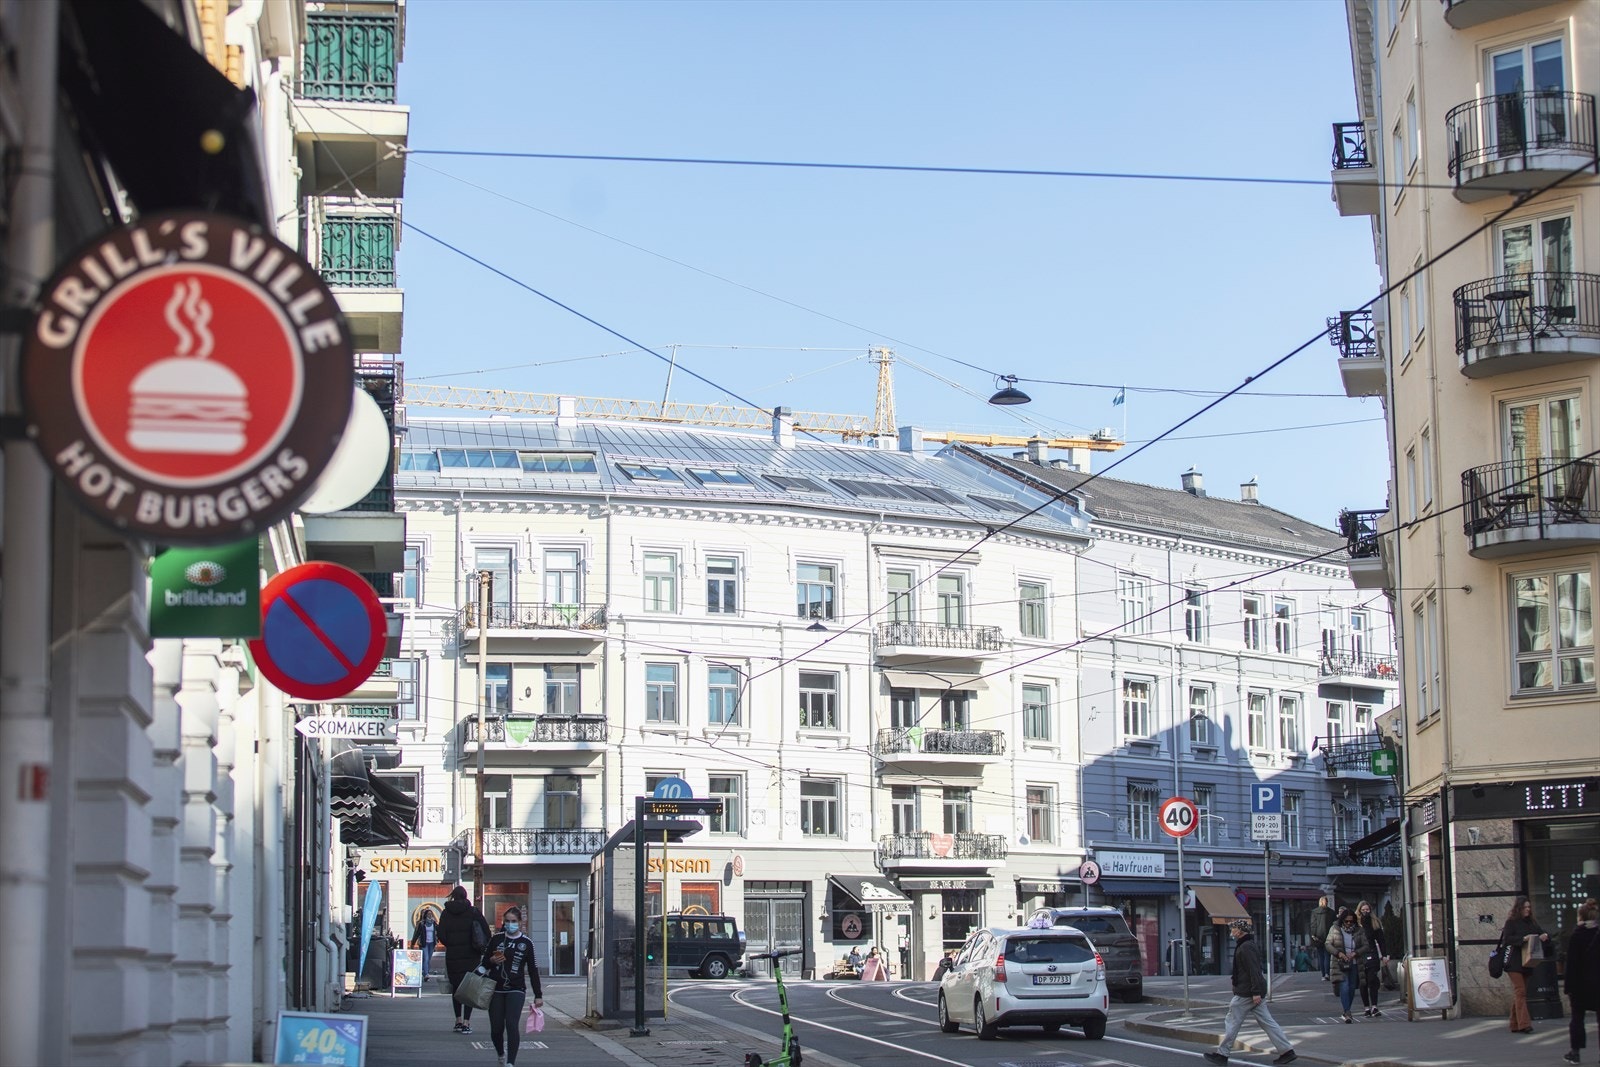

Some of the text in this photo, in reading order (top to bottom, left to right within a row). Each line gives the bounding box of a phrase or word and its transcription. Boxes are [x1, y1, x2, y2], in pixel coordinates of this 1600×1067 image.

[229, 227, 342, 353] VILLE
[56, 440, 309, 528] HOT BURGERS
[164, 588, 247, 607] brilleland
[308, 720, 386, 737] SKOMAKER
[660, 783, 682, 799] 10
[1258, 787, 1274, 810] P
[1525, 783, 1586, 810] LETT
[1166, 806, 1192, 826] 40
[370, 857, 441, 873] SYNSAM
[647, 857, 711, 873] SYNSAM
[1112, 861, 1153, 874] Havfruen
[1049, 975, 1070, 983] 97733
